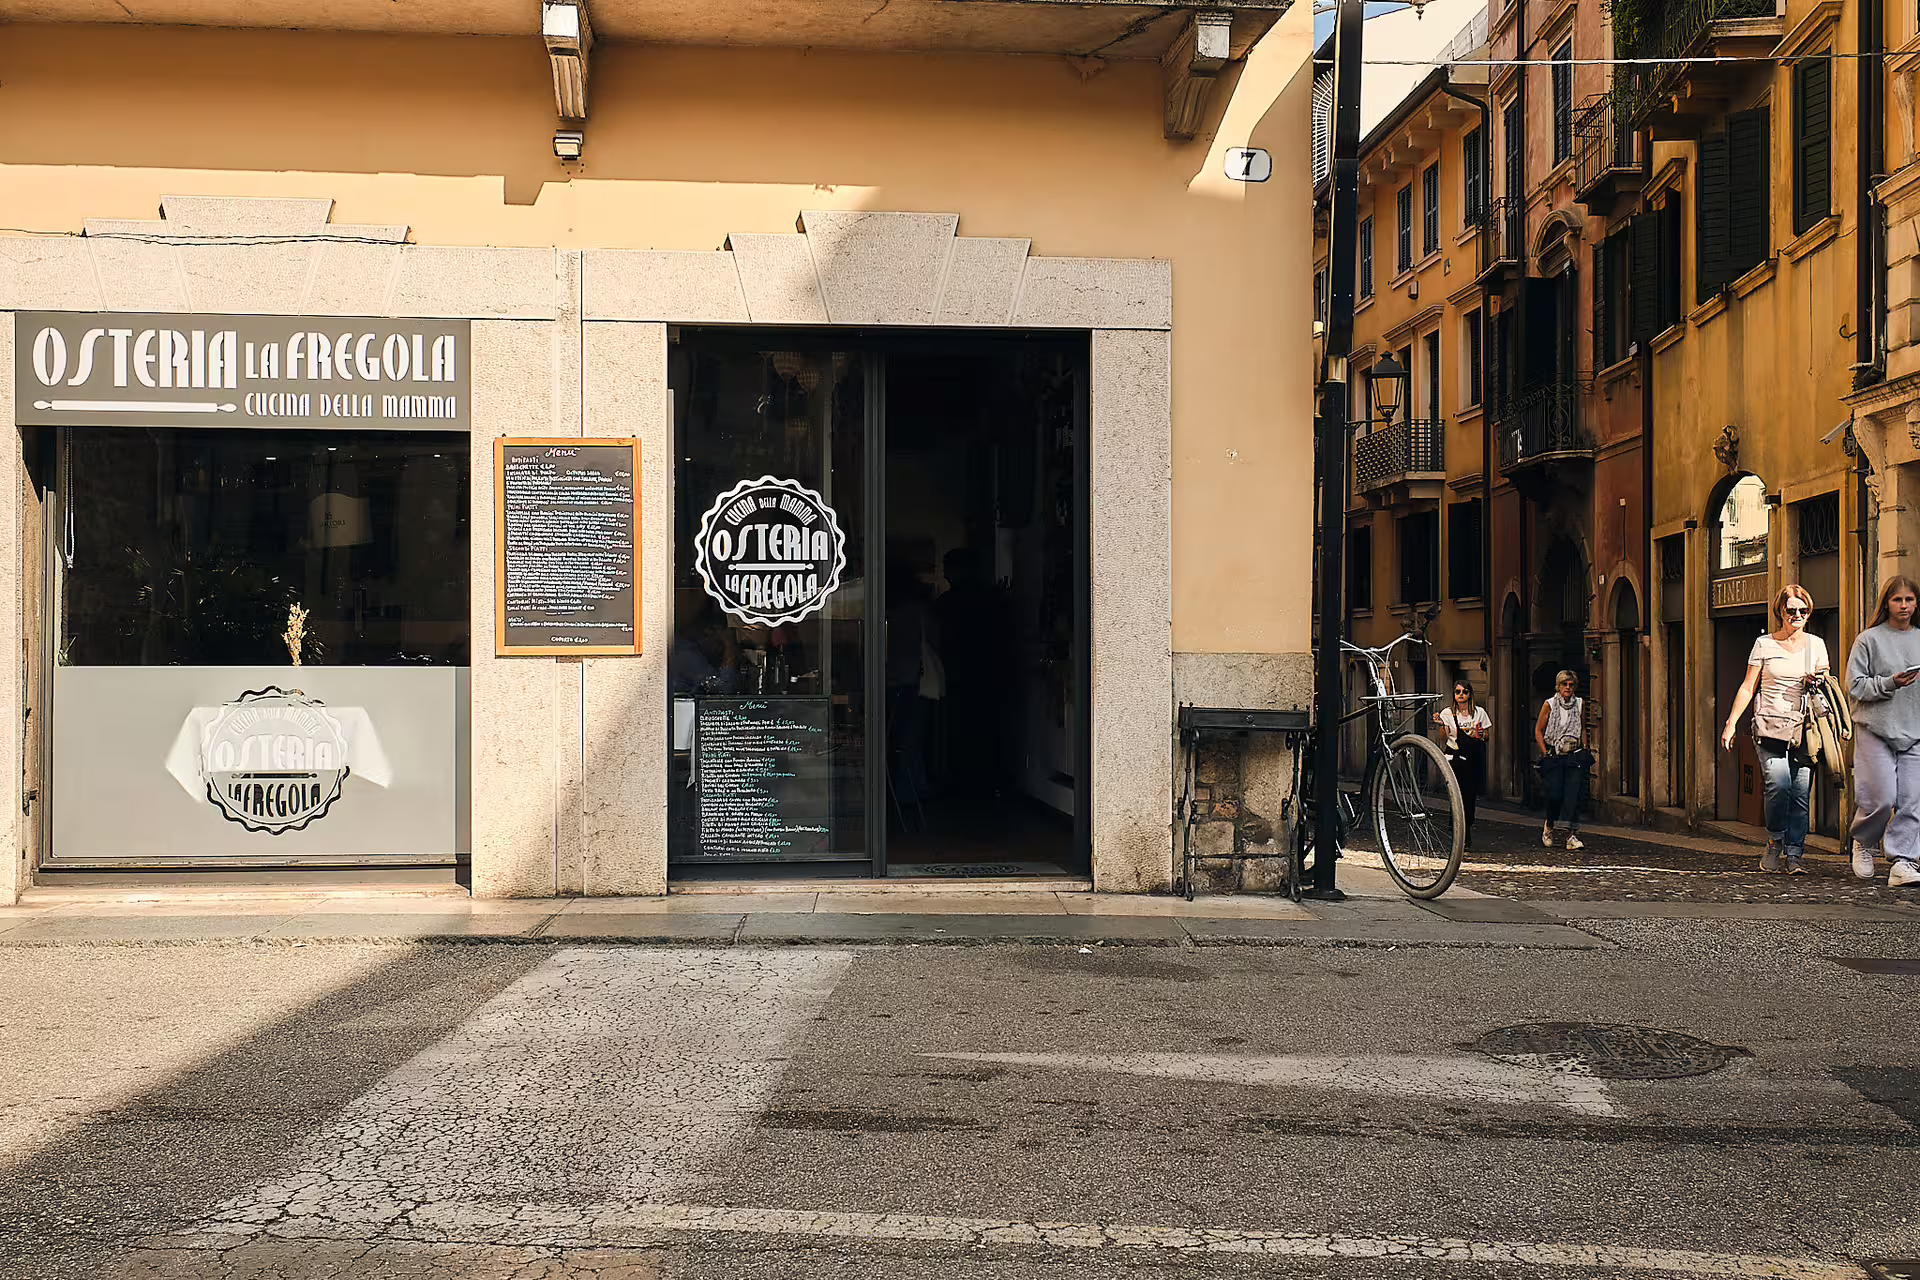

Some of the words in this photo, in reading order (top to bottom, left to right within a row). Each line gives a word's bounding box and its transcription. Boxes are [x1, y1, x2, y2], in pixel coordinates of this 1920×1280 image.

[1241, 151, 1257, 176] 7
[32, 326, 238, 389] OSTERIA
[245, 342, 279, 379] LA
[286, 331, 456, 382] FREGOLA
[244, 393, 311, 417] CUCINA
[319, 394, 373, 417] DELLA
[382, 395, 456, 419] MAMMA
[724, 495, 757, 526] CUCINA
[758, 497, 777, 509] DELLA
[780, 493, 818, 526] MAMMA
[712, 523, 829, 561] OSTERIA
[725, 574, 740, 594] LA
[740, 573, 818, 609] FREGOLA
[214, 734, 333, 769] OSTERIA
[228, 783, 242, 802] LA
[242, 783, 321, 817] FREGOLA
